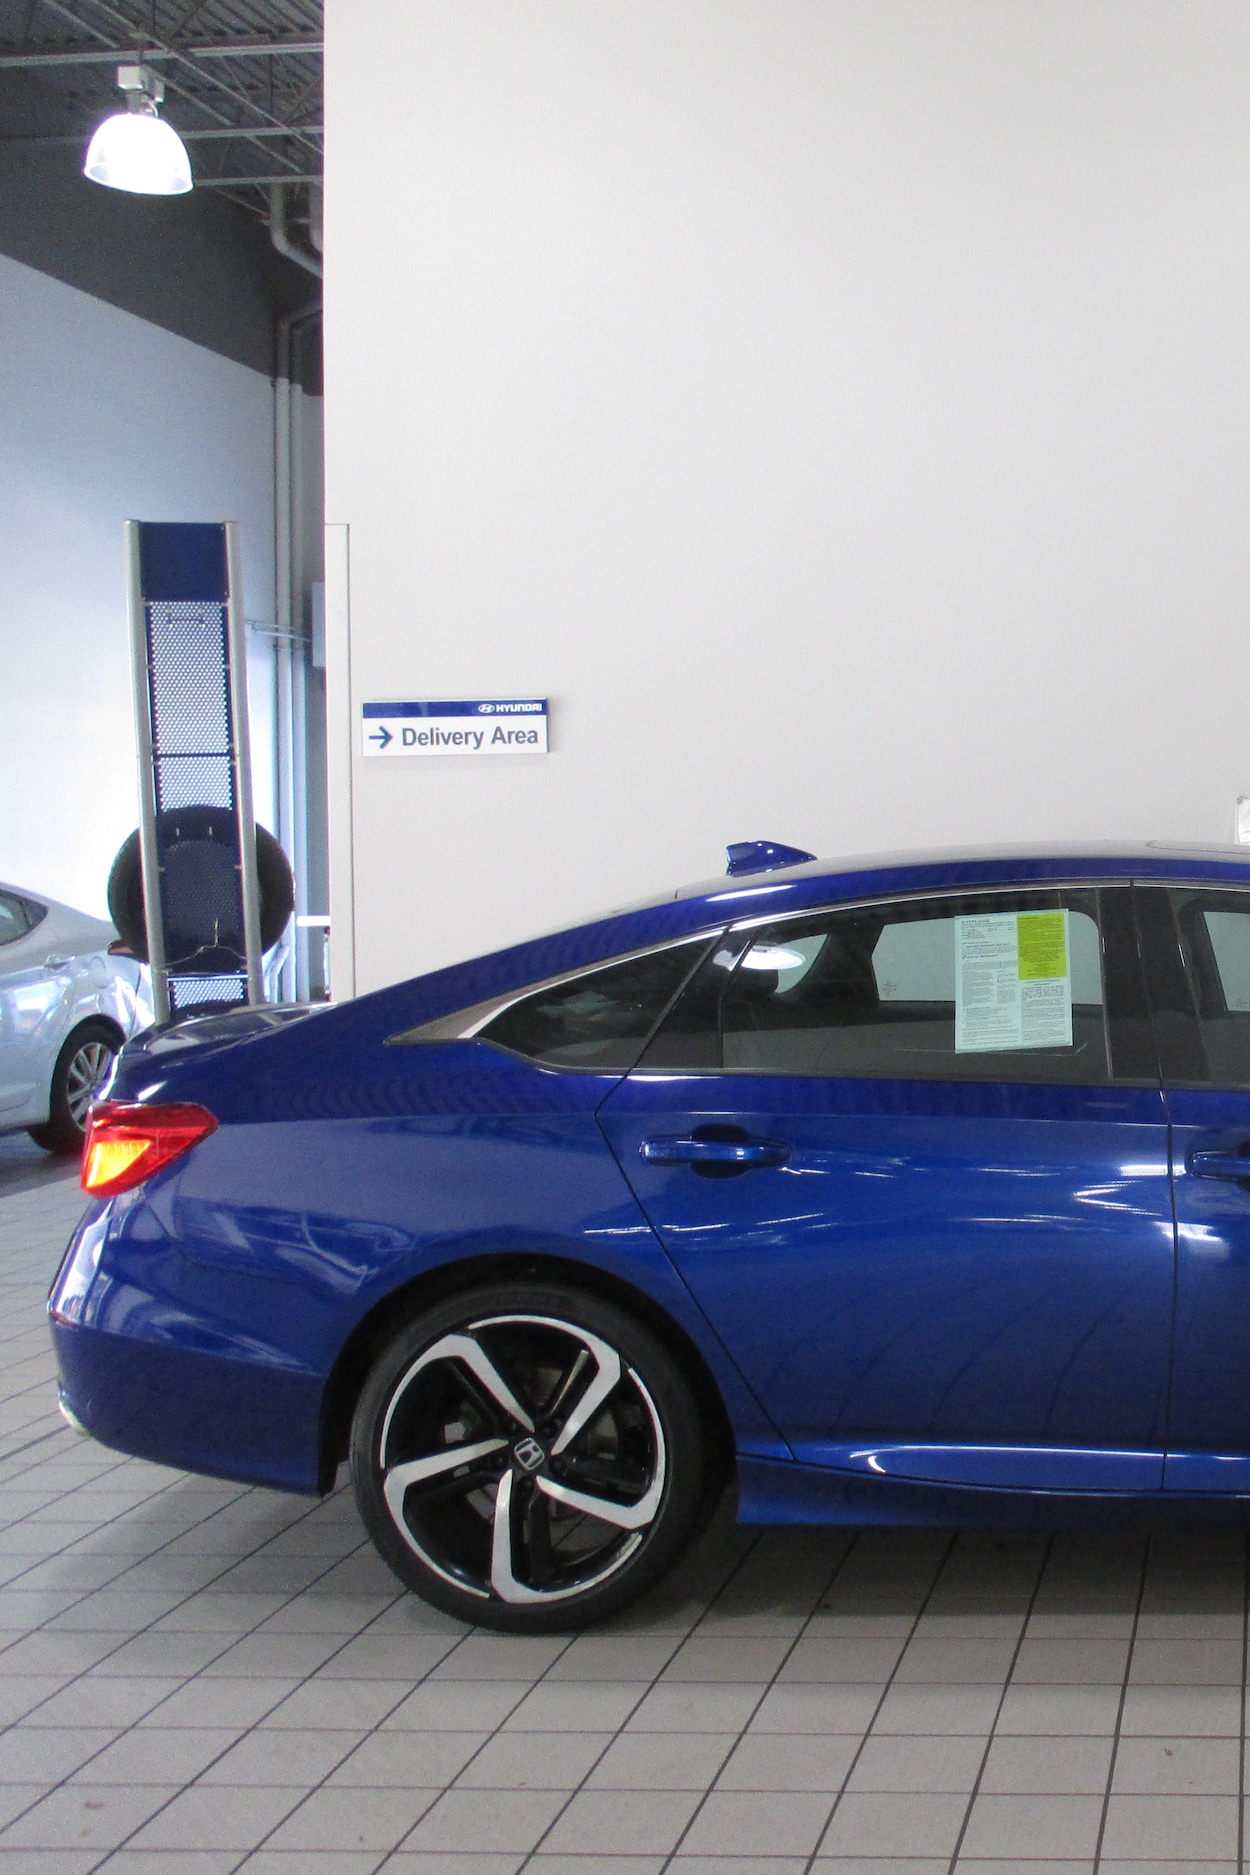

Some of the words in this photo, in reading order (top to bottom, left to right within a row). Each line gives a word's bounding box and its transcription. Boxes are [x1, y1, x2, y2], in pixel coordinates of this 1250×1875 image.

[496, 703, 542, 712] HYUNDAI
[402, 727, 484, 749] Delivery
[491, 726, 538, 744] Area
